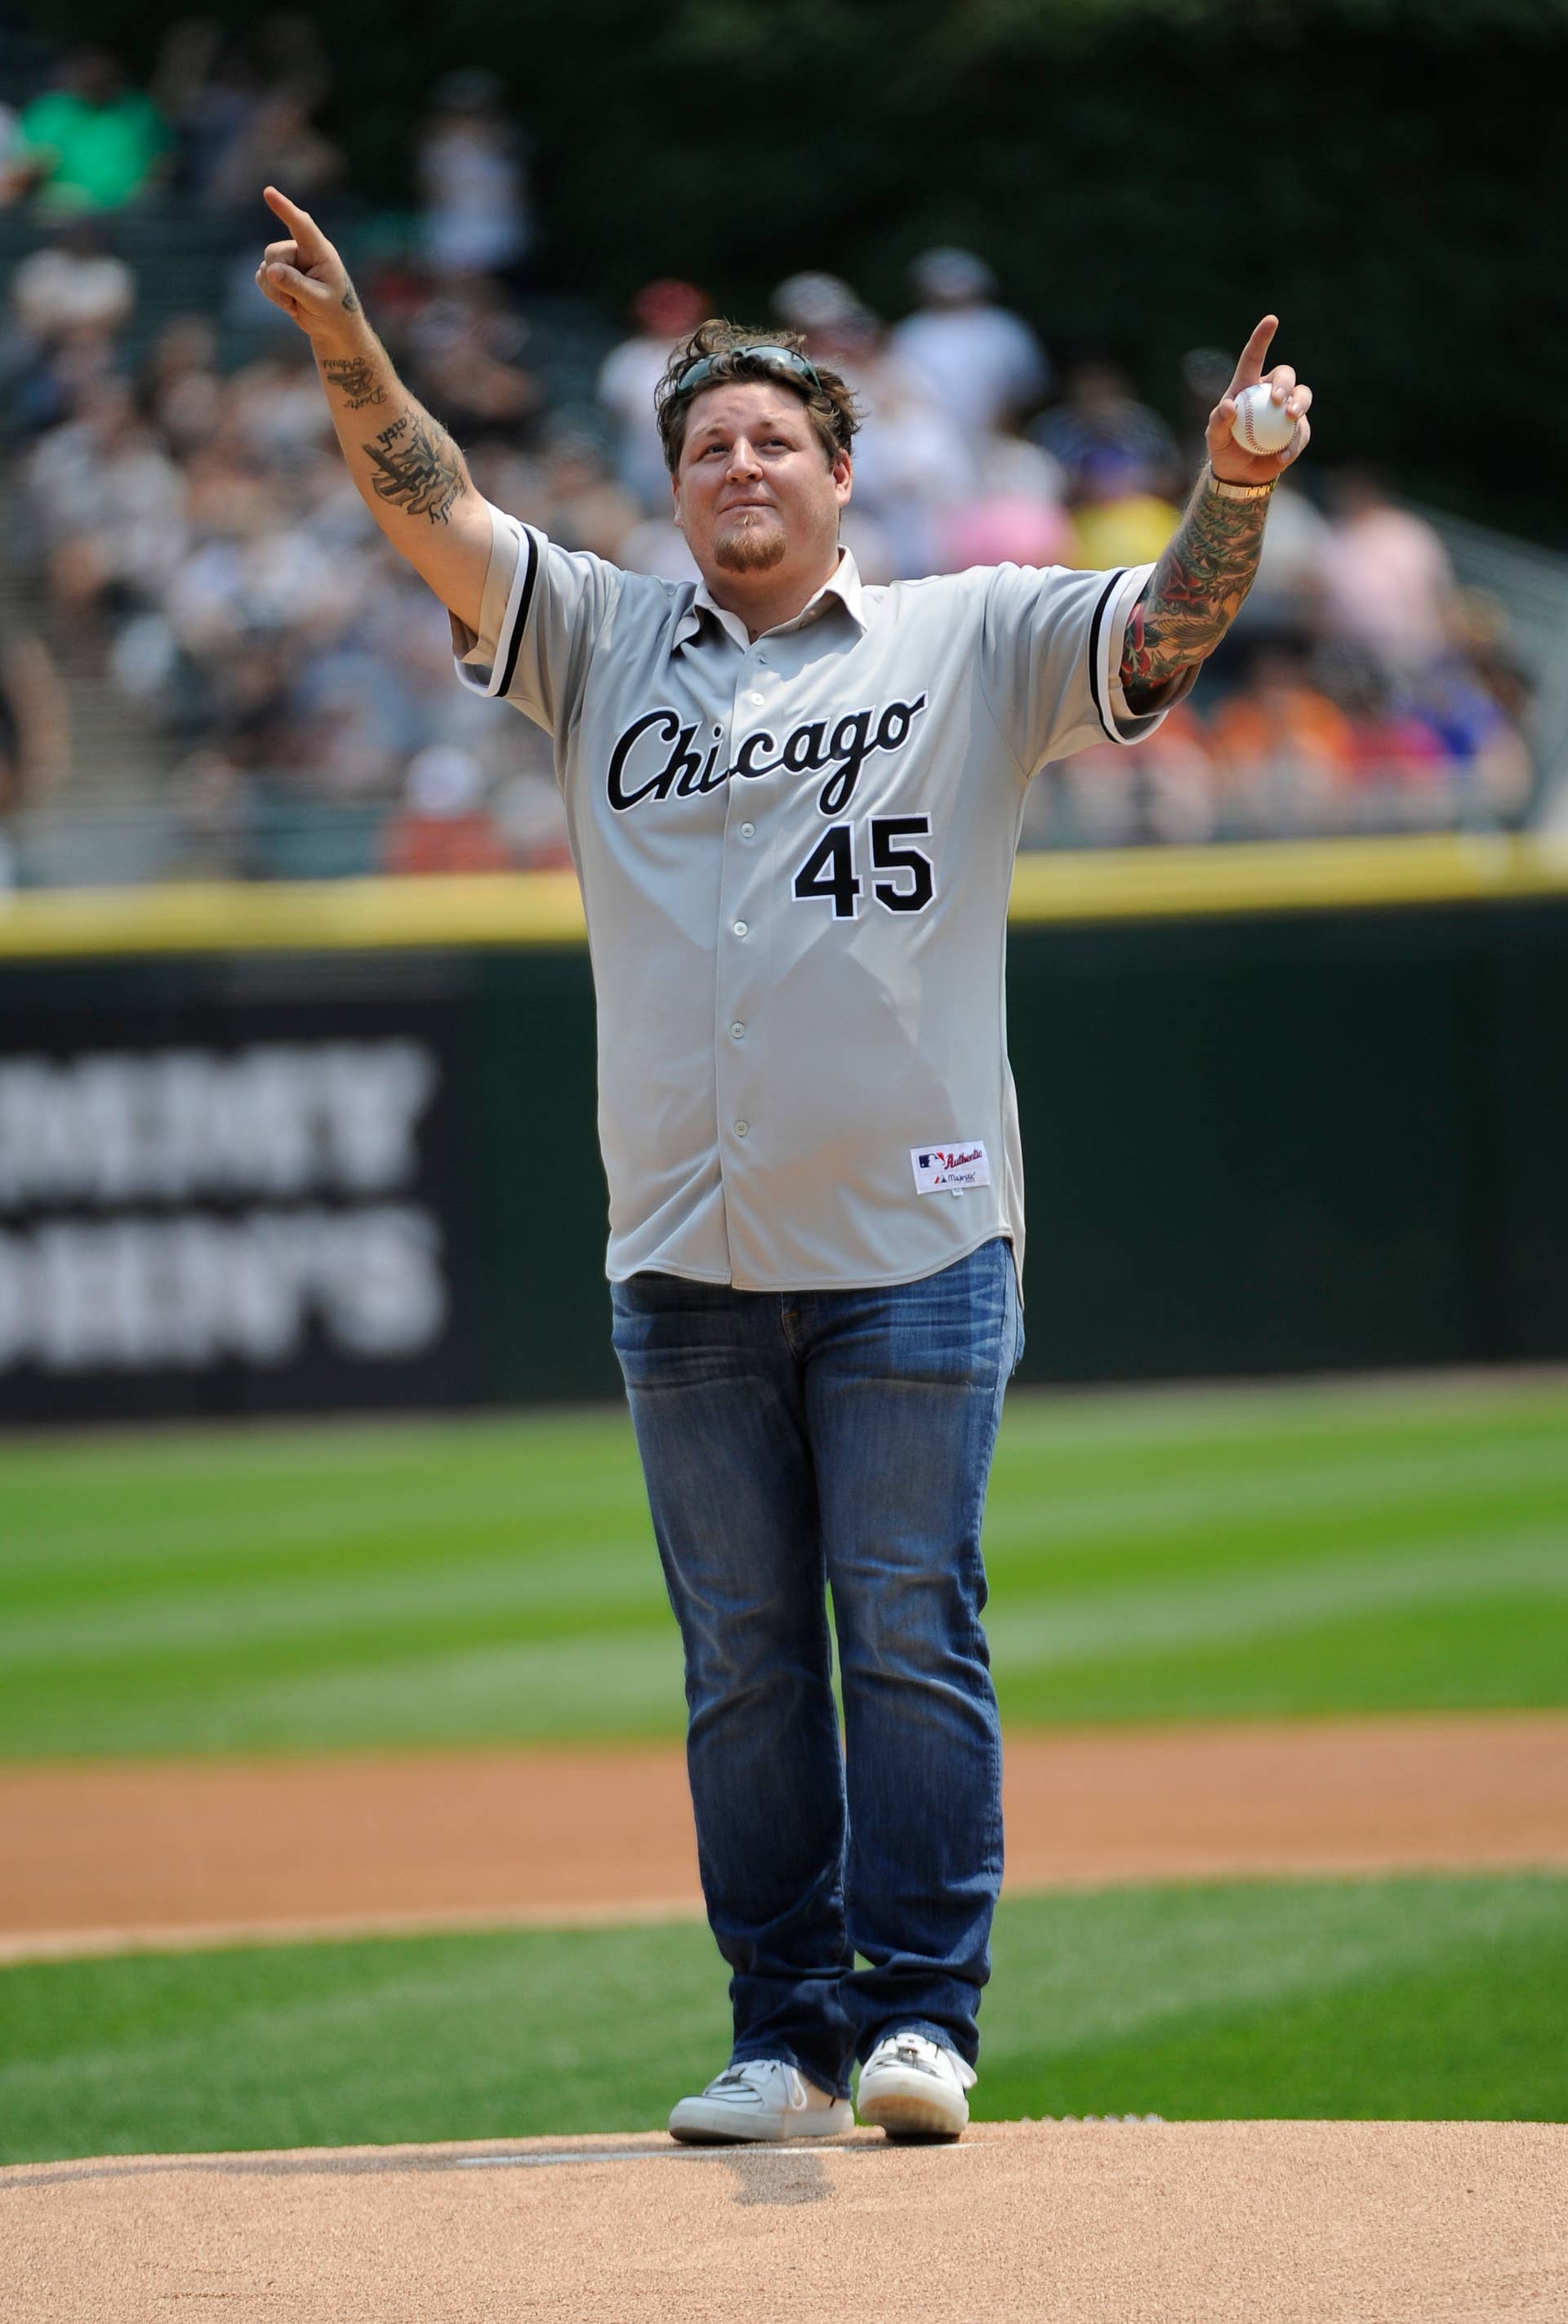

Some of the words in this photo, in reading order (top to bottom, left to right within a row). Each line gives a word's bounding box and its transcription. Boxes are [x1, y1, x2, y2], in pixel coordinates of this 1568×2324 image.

[607, 691, 928, 816] Chicago
[791, 813, 937, 921] 45
[944, 1148, 982, 1169] Authentic
